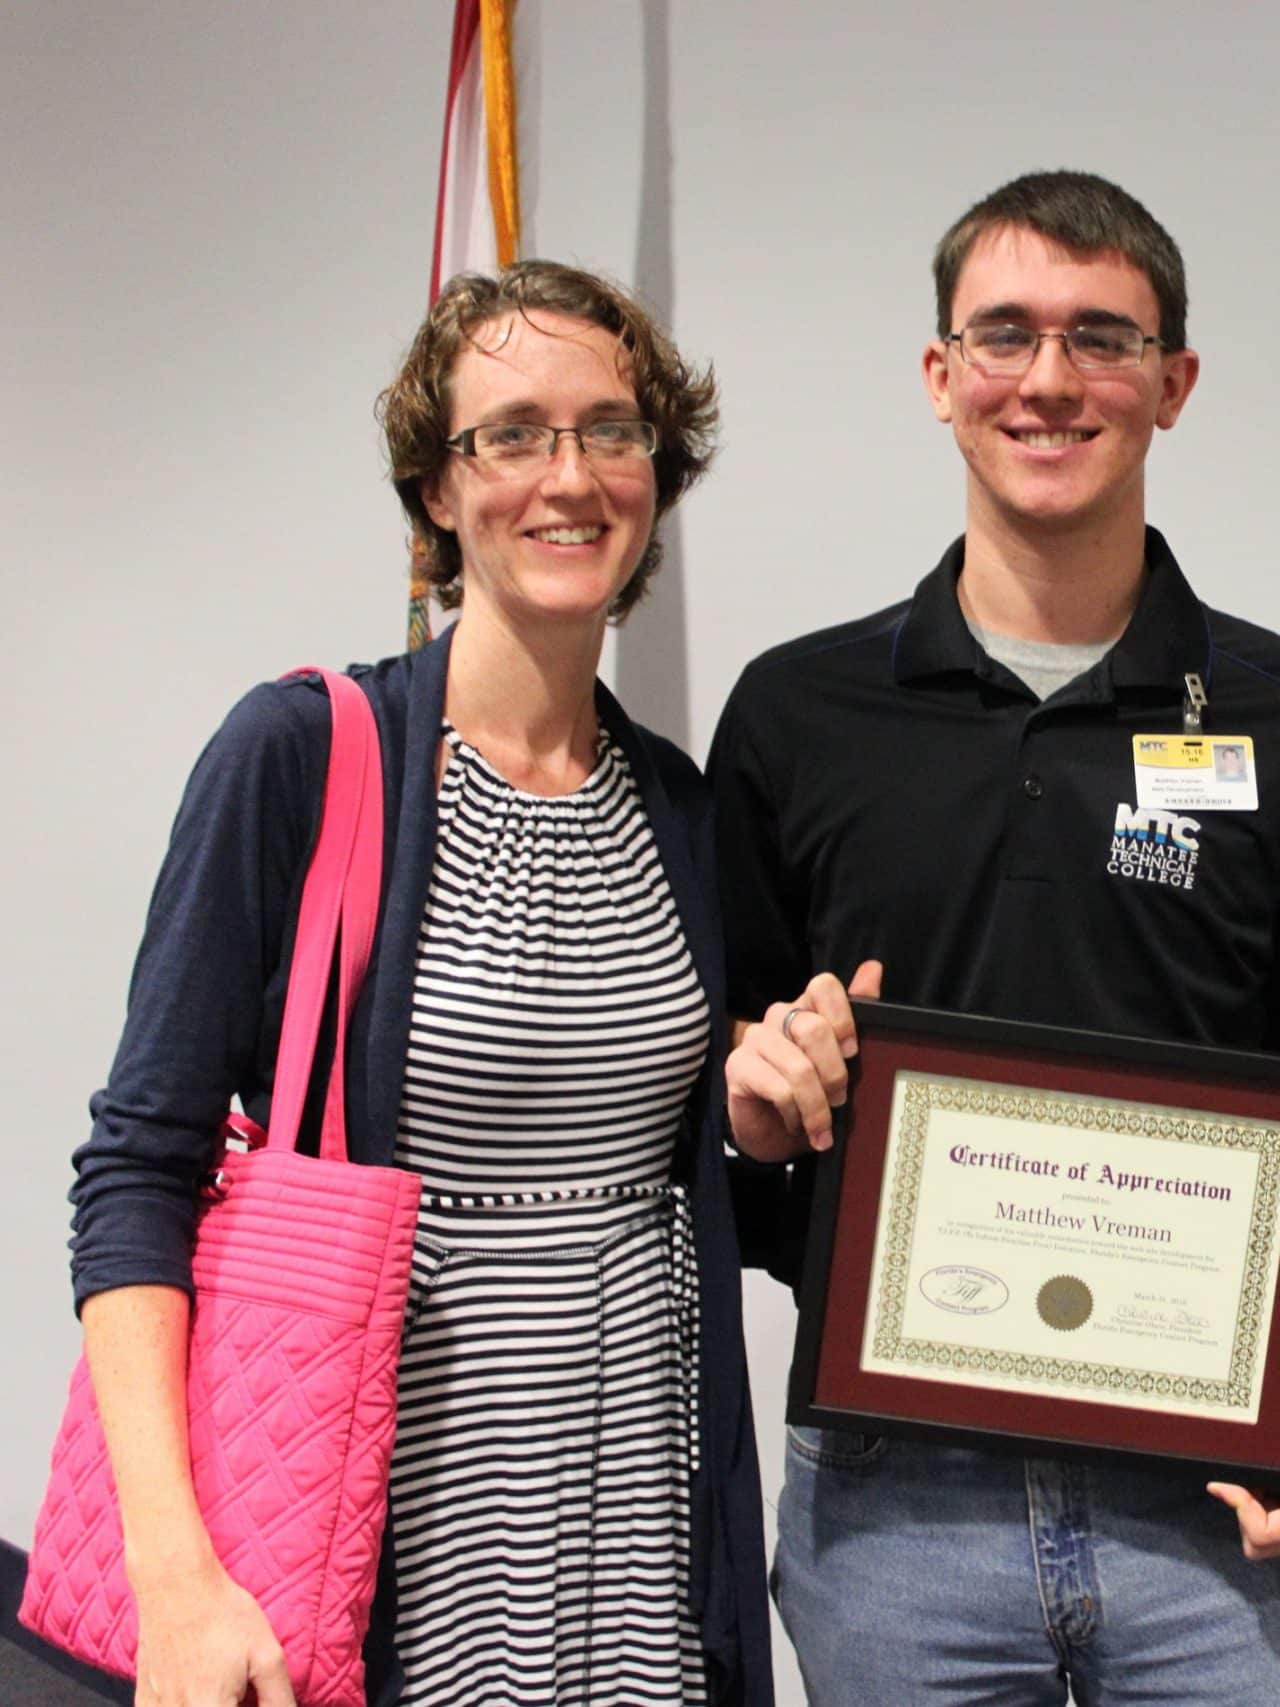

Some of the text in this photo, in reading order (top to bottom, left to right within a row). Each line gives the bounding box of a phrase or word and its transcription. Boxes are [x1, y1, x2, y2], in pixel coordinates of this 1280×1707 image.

[1114, 802, 1202, 852] MTC
[1110, 847, 1196, 877] TECHNICAL
[1111, 836, 1199, 865] MANATEE
[1106, 860, 1195, 890] COLLEGE
[949, 1143, 1232, 1201] Certificate of Appreciation
[994, 1201, 1173, 1243] Matthew Vreman
